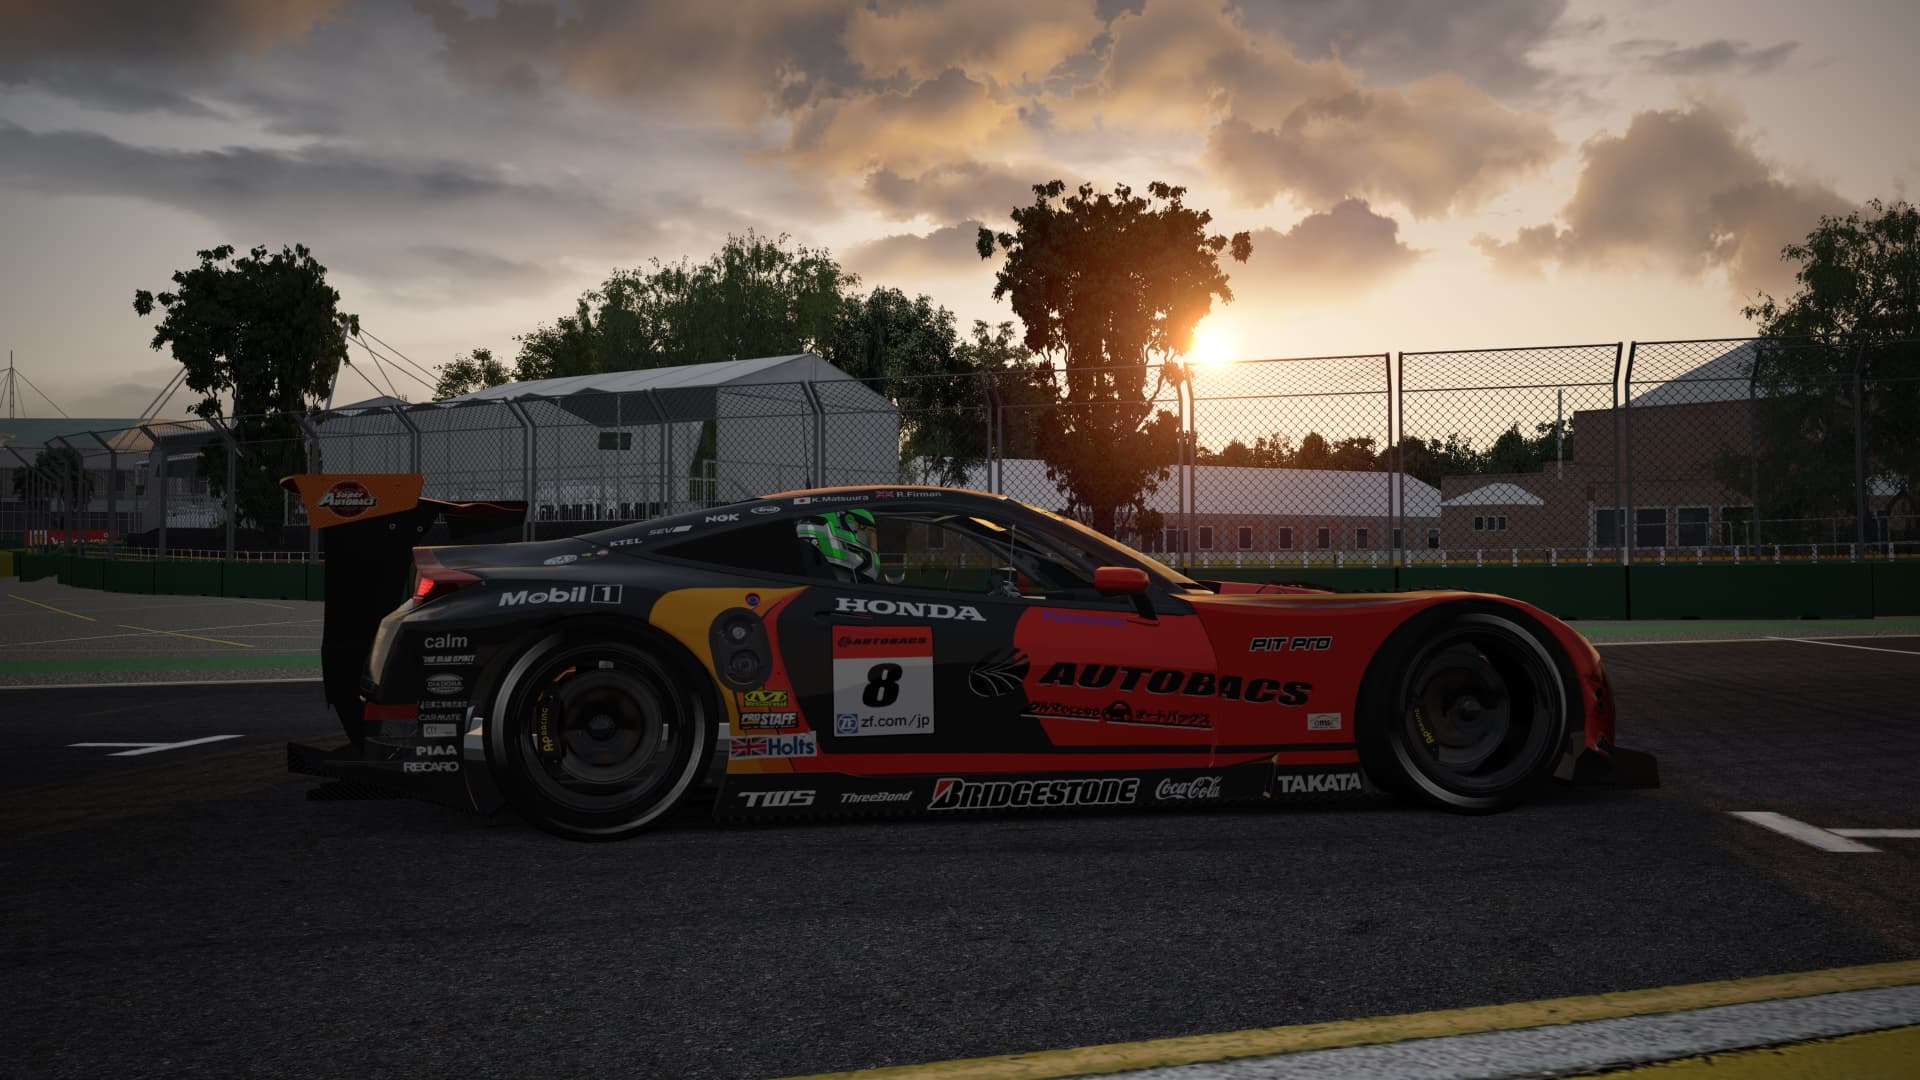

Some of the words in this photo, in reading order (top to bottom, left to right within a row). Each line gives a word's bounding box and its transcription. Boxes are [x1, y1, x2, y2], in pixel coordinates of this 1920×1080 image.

[705, 513, 740, 523] NGK
[498, 586, 588, 607] Mobil
[834, 597, 987, 622] HONDA
[424, 634, 468, 648] calm
[851, 636, 929, 646] AUTOBACS
[1248, 636, 1289, 653] PIT
[862, 663, 903, 708] 8
[1038, 662, 1313, 706] AUTOBACS
[760, 712, 798, 726] STAFF
[861, 715, 930, 728] zf.com/jp
[415, 744, 458, 757] PIAA
[768, 735, 815, 755] Holts
[402, 761, 460, 774] RECARO
[1277, 773, 1362, 793] TAKATA
[737, 789, 817, 808] TWS
[839, 790, 913, 804] ThreeBond
[928, 777, 1140, 810] BRIDGESTONE
